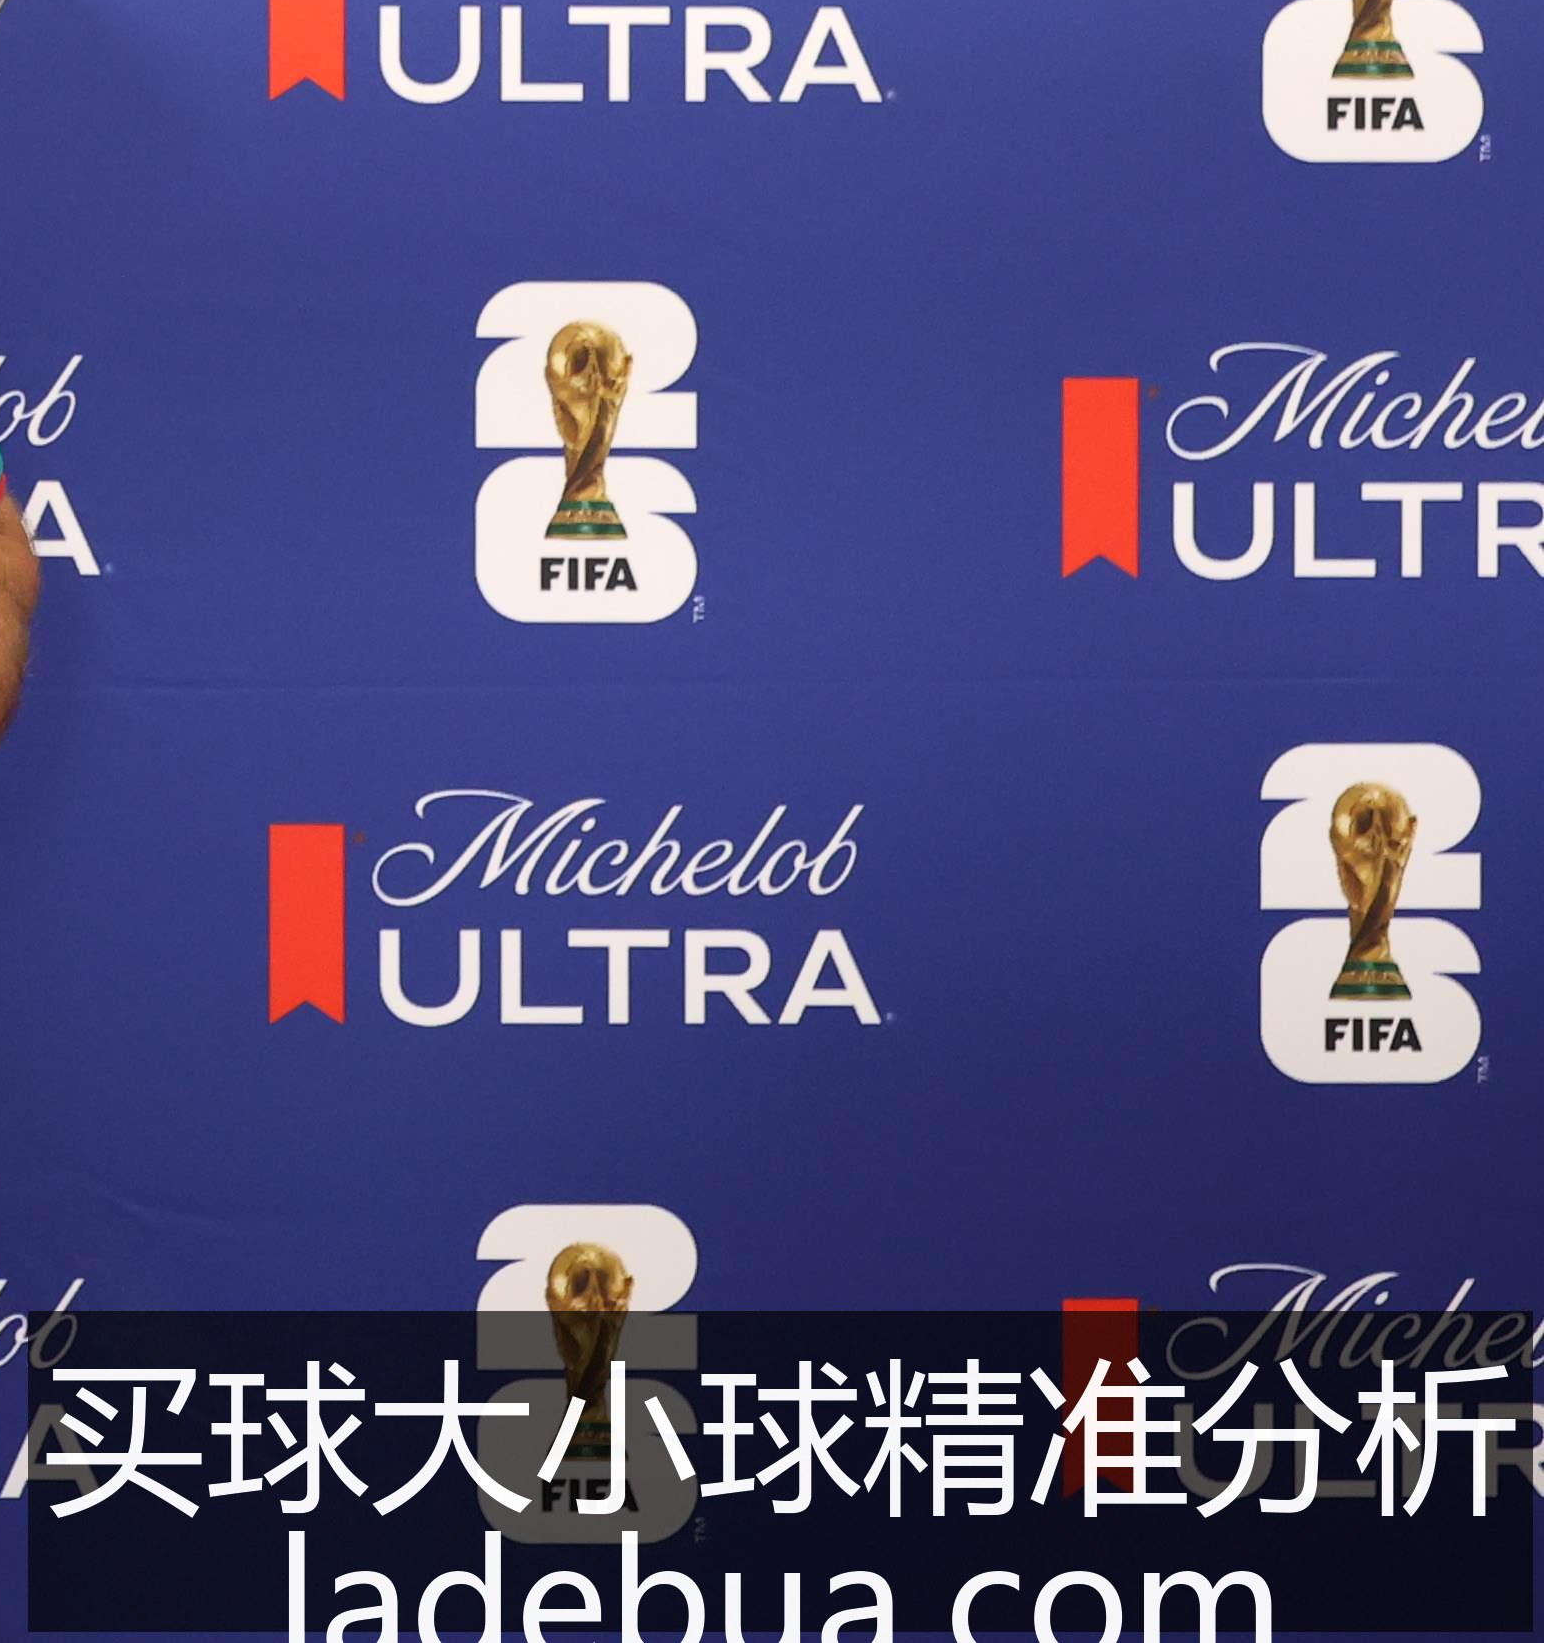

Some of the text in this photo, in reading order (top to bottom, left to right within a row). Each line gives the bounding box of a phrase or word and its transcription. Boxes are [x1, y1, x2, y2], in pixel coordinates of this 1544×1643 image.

[380, 6, 882, 103] ULTRA
[1328, 98, 1423, 129] FIFA
[541, 558, 636, 590] FIFA
[372, 790, 863, 906] Michelob
[380, 929, 881, 1026] ULTRA
[1325, 1019, 1421, 1051] FIFA
